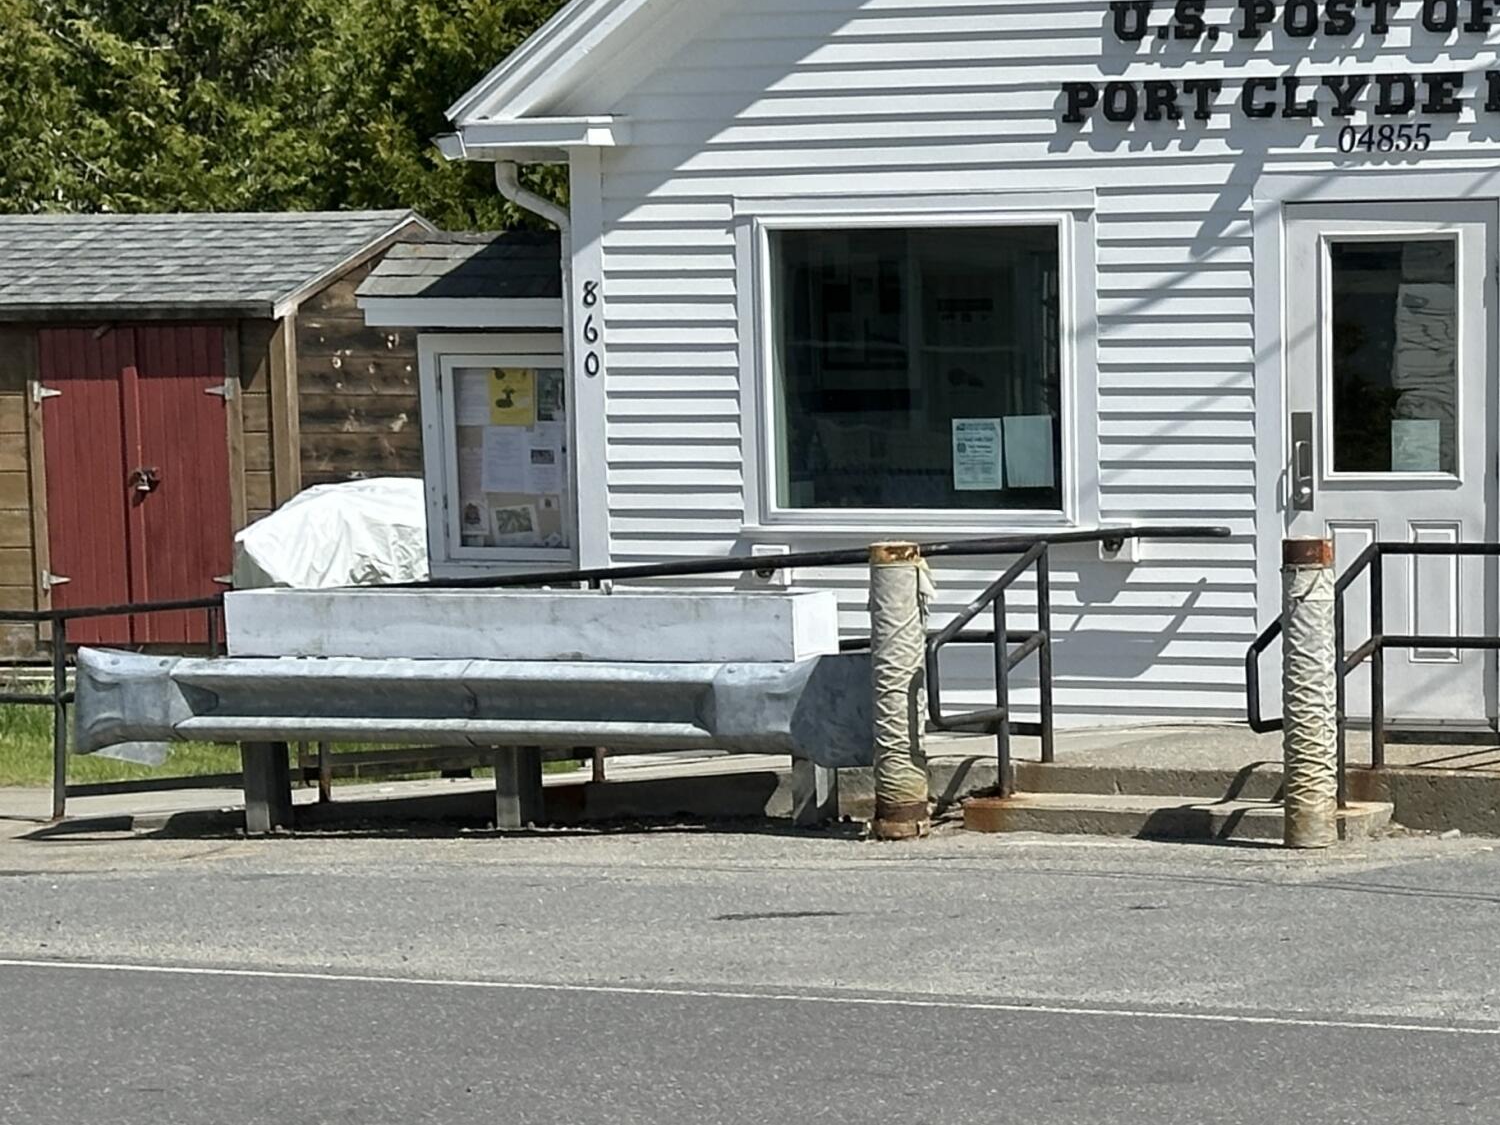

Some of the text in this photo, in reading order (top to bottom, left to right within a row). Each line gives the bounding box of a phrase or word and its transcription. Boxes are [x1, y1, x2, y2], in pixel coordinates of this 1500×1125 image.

[1109, 0, 1220, 42] U.S.
[1061, 78, 1225, 125] PORT
[1241, 71, 1465, 117] CLYDE
[1338, 123, 1432, 153] 04855
[583, 280, 600, 377] 860
